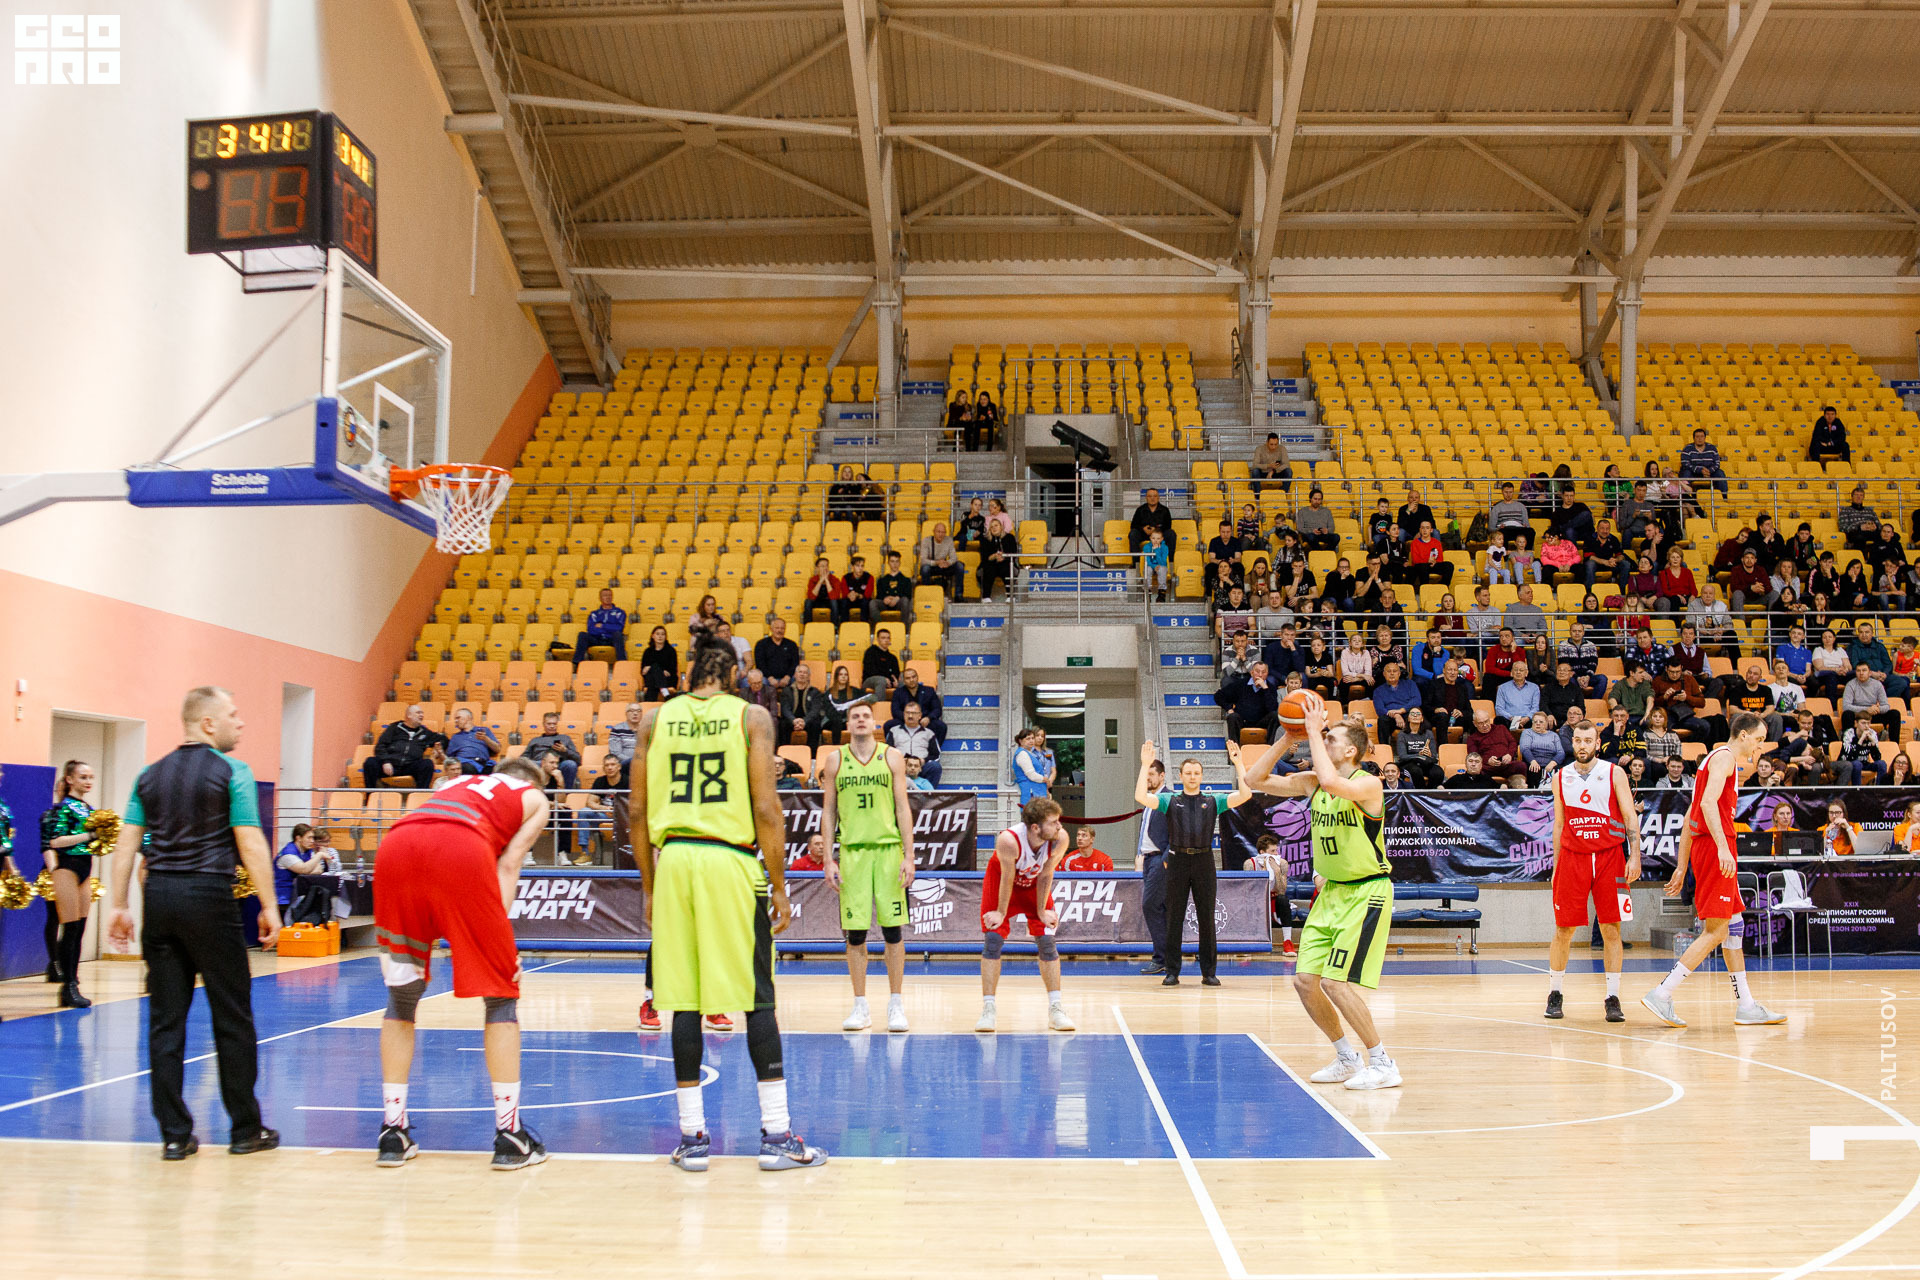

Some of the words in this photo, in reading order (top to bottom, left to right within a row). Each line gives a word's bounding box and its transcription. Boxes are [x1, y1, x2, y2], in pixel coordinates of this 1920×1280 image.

[968, 620, 976, 628] A
[980, 620, 987, 628] 6
[1170, 618, 1178, 626] B
[1183, 618, 1190, 626] 6
[964, 657, 972, 665] A
[977, 657, 984, 665] 5
[1175, 657, 1183, 665] B
[1188, 657, 1195, 665] 5
[962, 698, 970, 706] A
[975, 698, 983, 706] 4
[1180, 697, 1188, 705] B
[1193, 697, 1201, 705] 4
[960, 741, 968, 750] A
[973, 741, 981, 750] 3
[1185, 740, 1193, 748] B
[1198, 740, 1206, 748] 3
[670, 752, 728, 804] 98
[857, 793, 874, 809] 31
[1580, 789, 1592, 804] 6
[913, 809, 970, 834] ДЛЯ
[1403, 815, 1425, 823] XXIX
[1569, 816, 1607, 825] СПАРТАК
[1383, 826, 1423, 834] ПИОНАТ
[1424, 826, 1465, 834] РОССИИ
[1583, 831, 1600, 839] ВТБ
[1320, 836, 1338, 856] 10
[1387, 838, 1433, 846] МУЖСКИХ
[1277, 839, 1313, 862] УПЕ
[1387, 849, 1412, 857] ЕЗОН
[1413, 849, 1450, 857] 2019/20
[1509, 840, 1553, 862] СУПЕ
[1288, 861, 1310, 877] ИГА
[1051, 881, 1117, 901] АРИ
[507, 900, 596, 920] МАТЧ
[1623, 899, 1632, 914] 6
[914, 920, 943, 934] ЛИГА
[1328, 948, 1348, 969] 10
